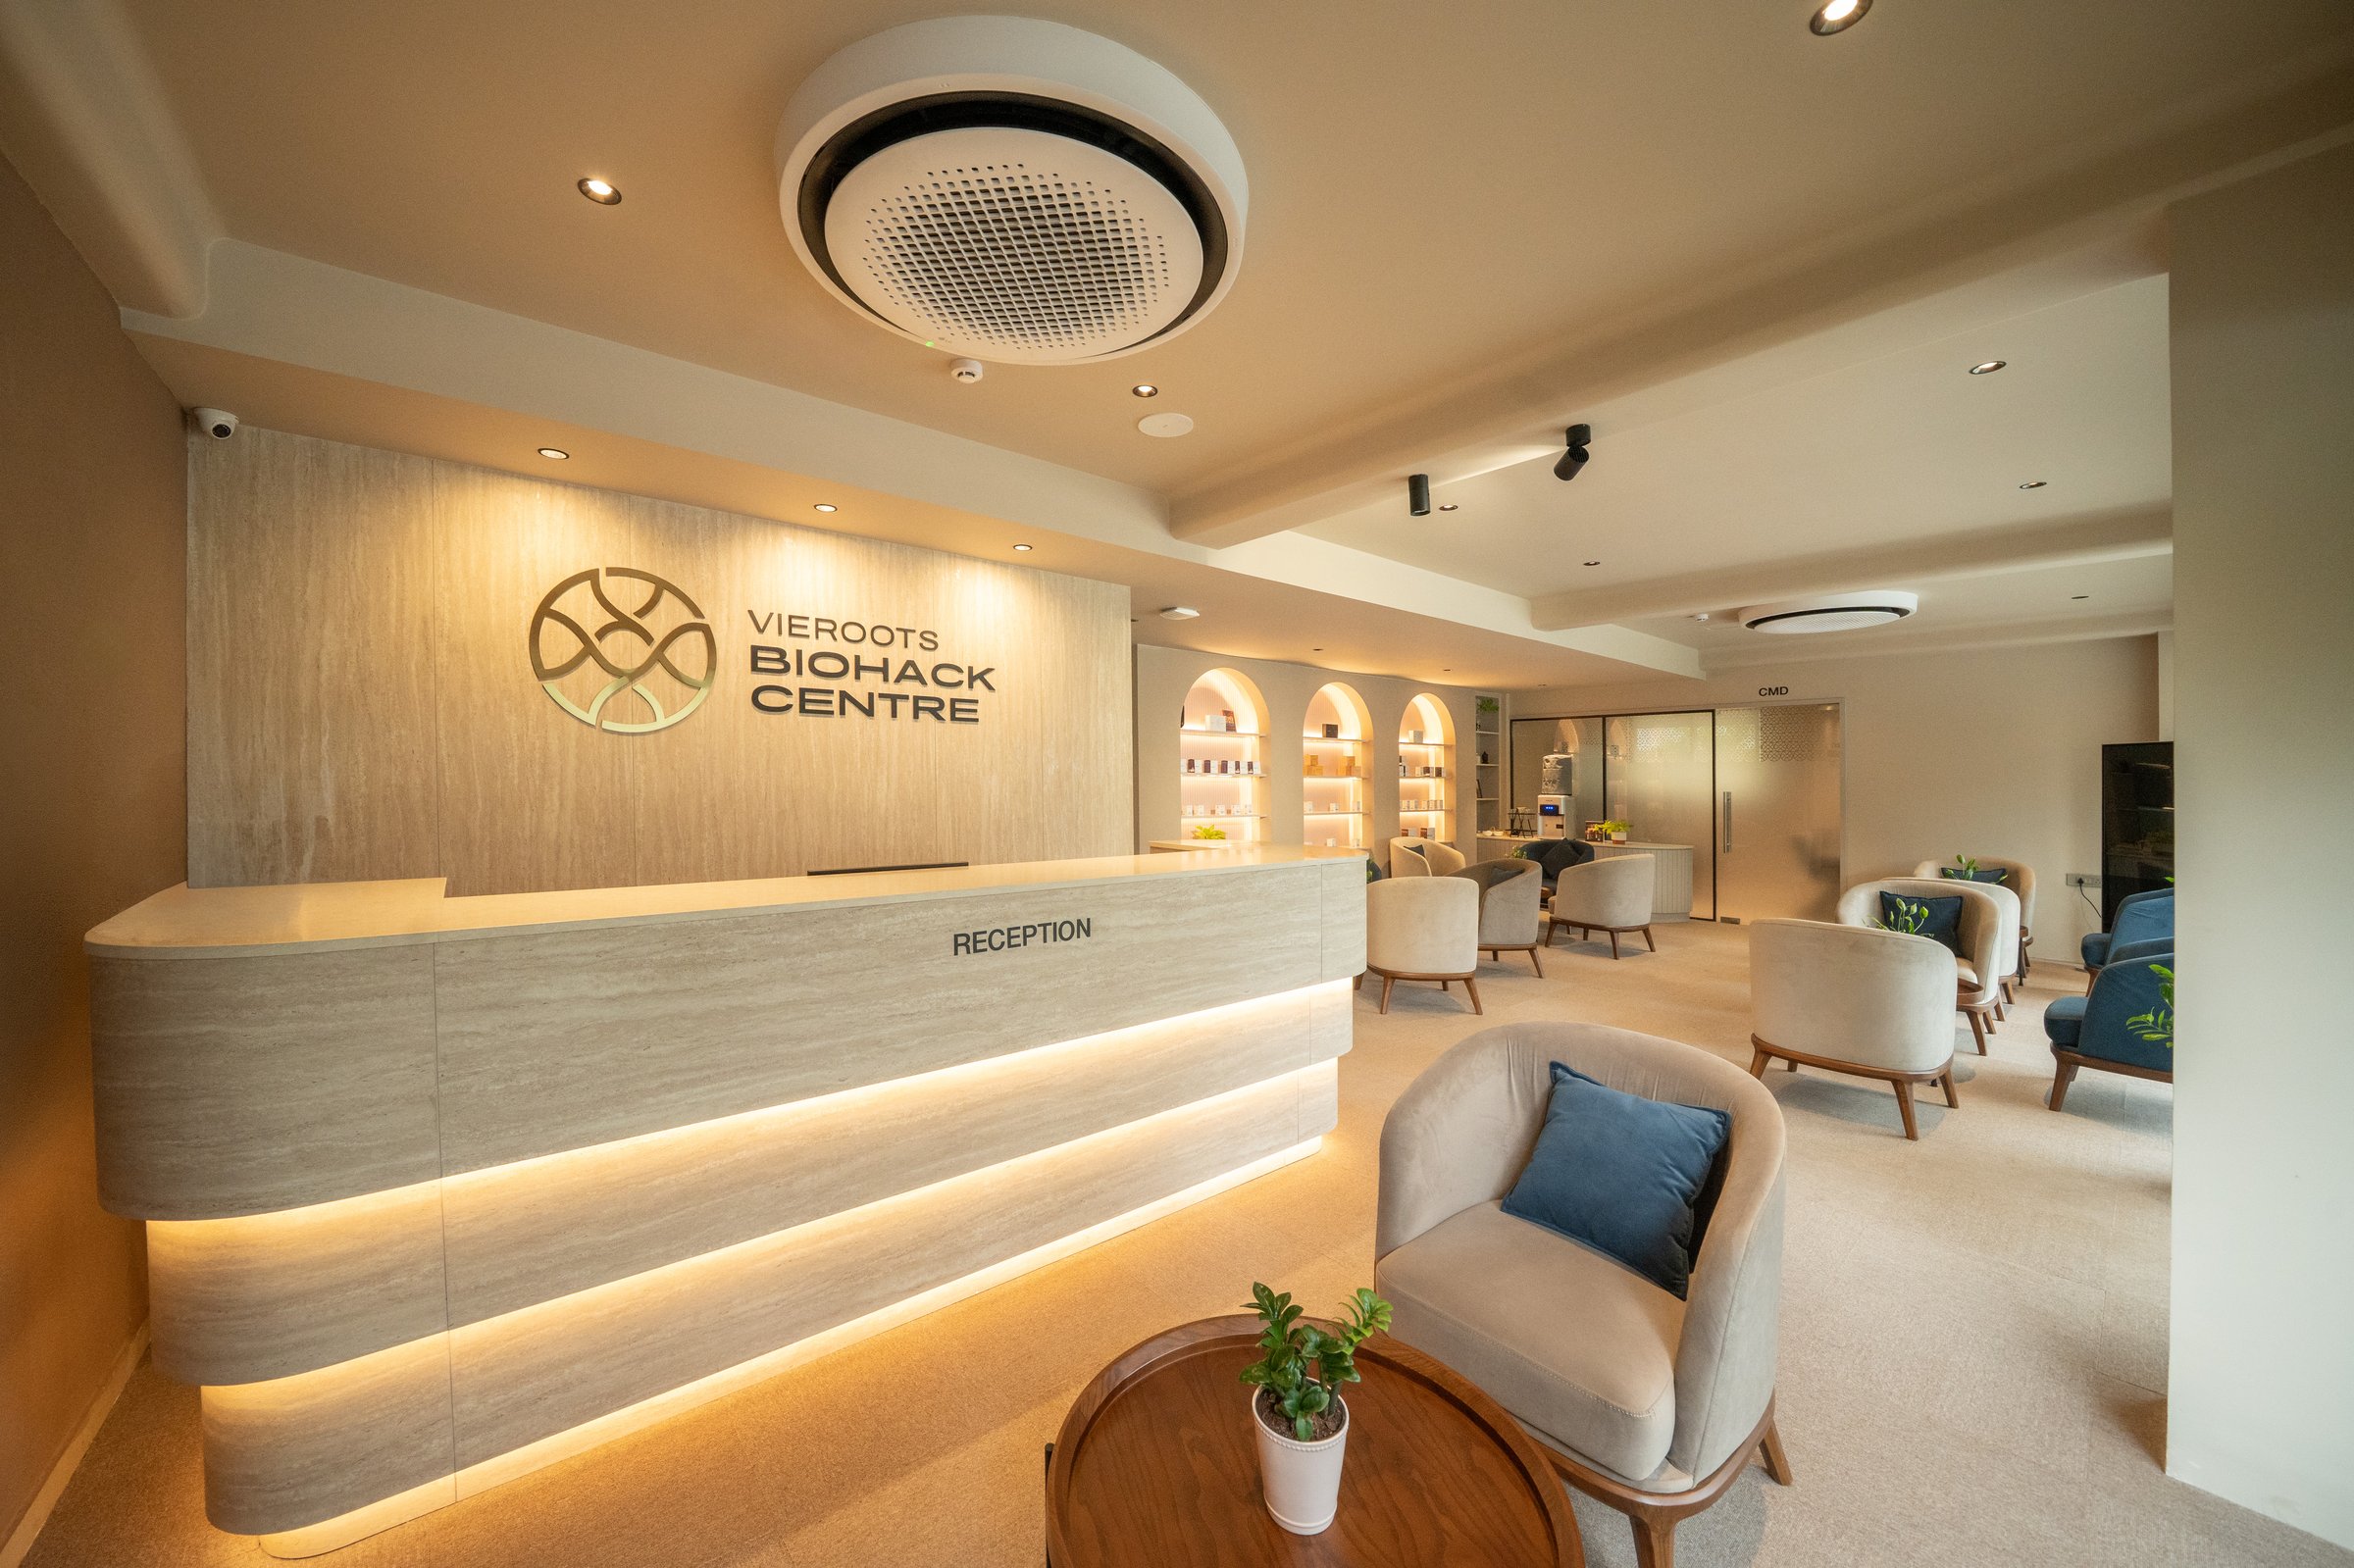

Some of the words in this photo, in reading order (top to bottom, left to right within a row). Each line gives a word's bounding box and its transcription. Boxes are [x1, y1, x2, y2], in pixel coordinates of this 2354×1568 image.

[747, 609, 939, 651] VIEROOTS
[750, 644, 996, 691] BIOHACK
[750, 684, 979, 723] CENTRE
[1759, 686, 1788, 696] CMD
[953, 917, 1091, 956] RECEPTION
